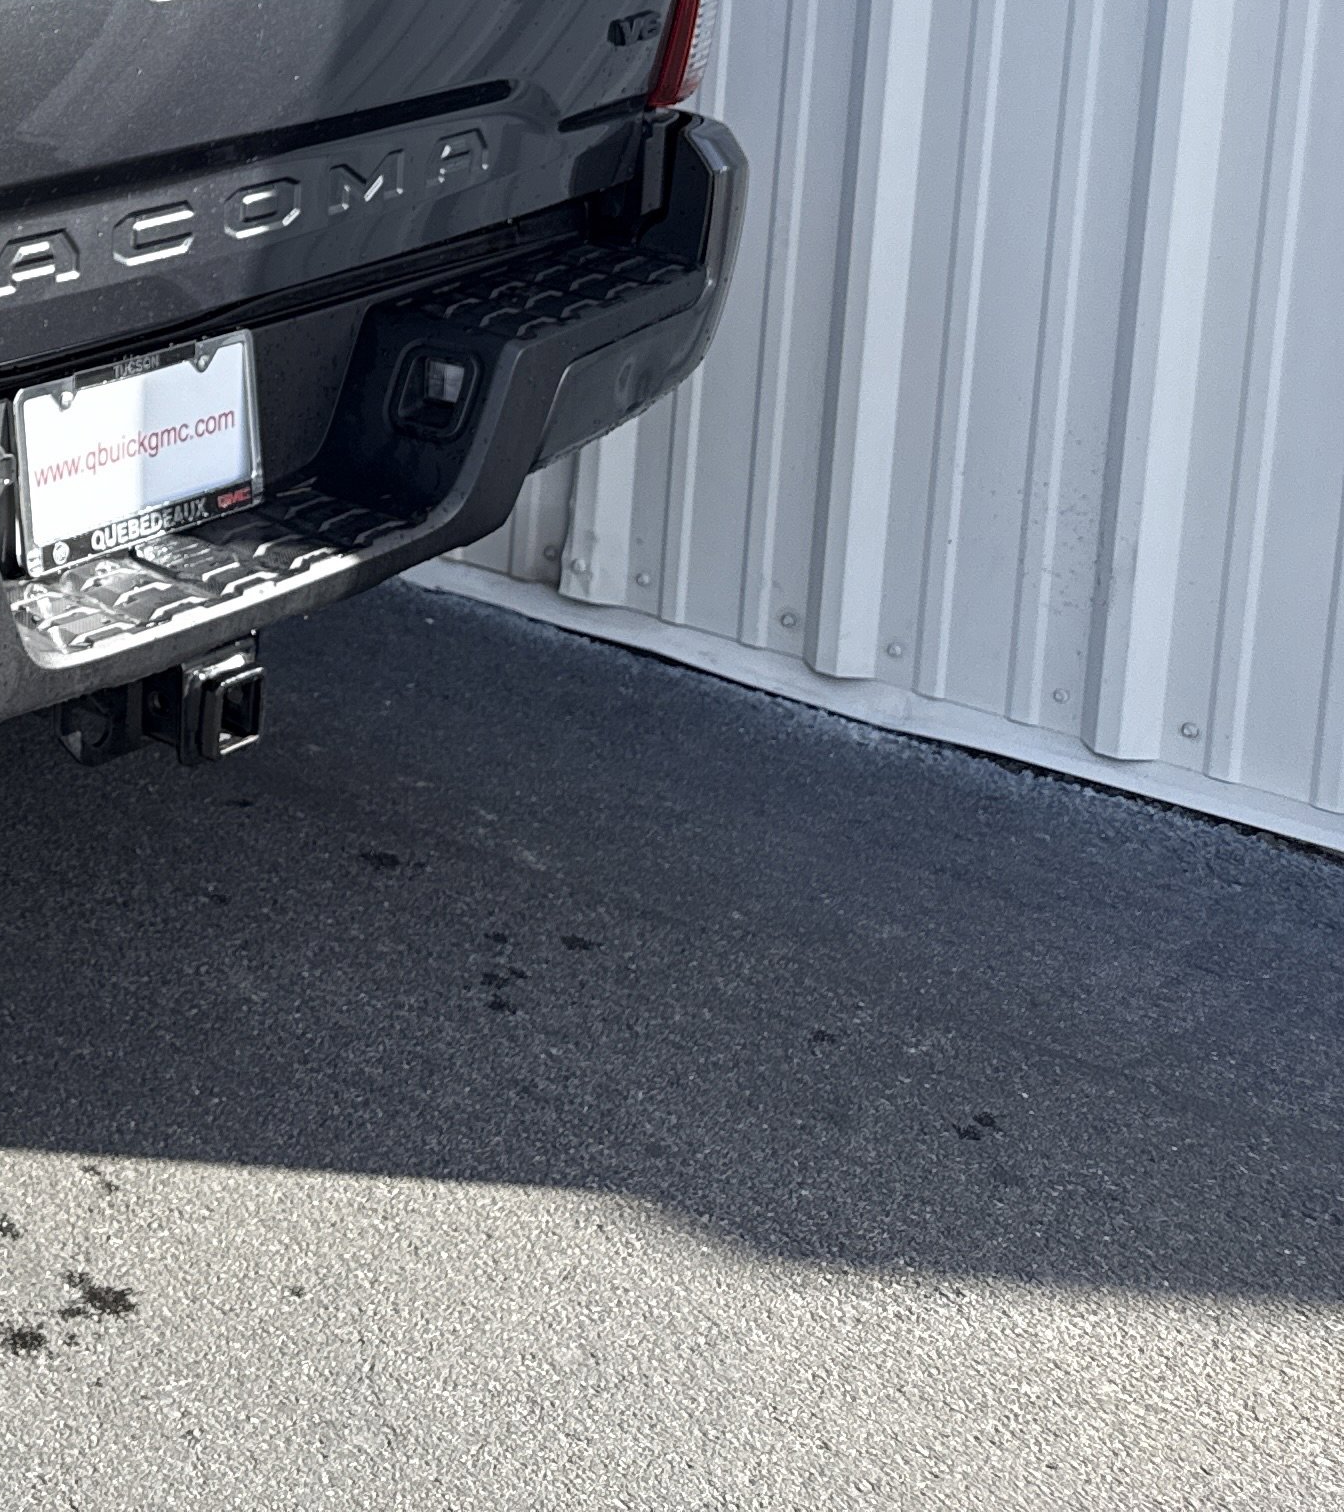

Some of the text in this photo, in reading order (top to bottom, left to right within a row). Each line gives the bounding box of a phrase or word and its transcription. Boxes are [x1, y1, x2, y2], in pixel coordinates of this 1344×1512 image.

[112, 354, 160, 380] TUCSON
[33, 408, 236, 488] www.qbuickgmc.com
[216, 487, 250, 510] GMC
[90, 496, 208, 552] QUEBEDEAUX
